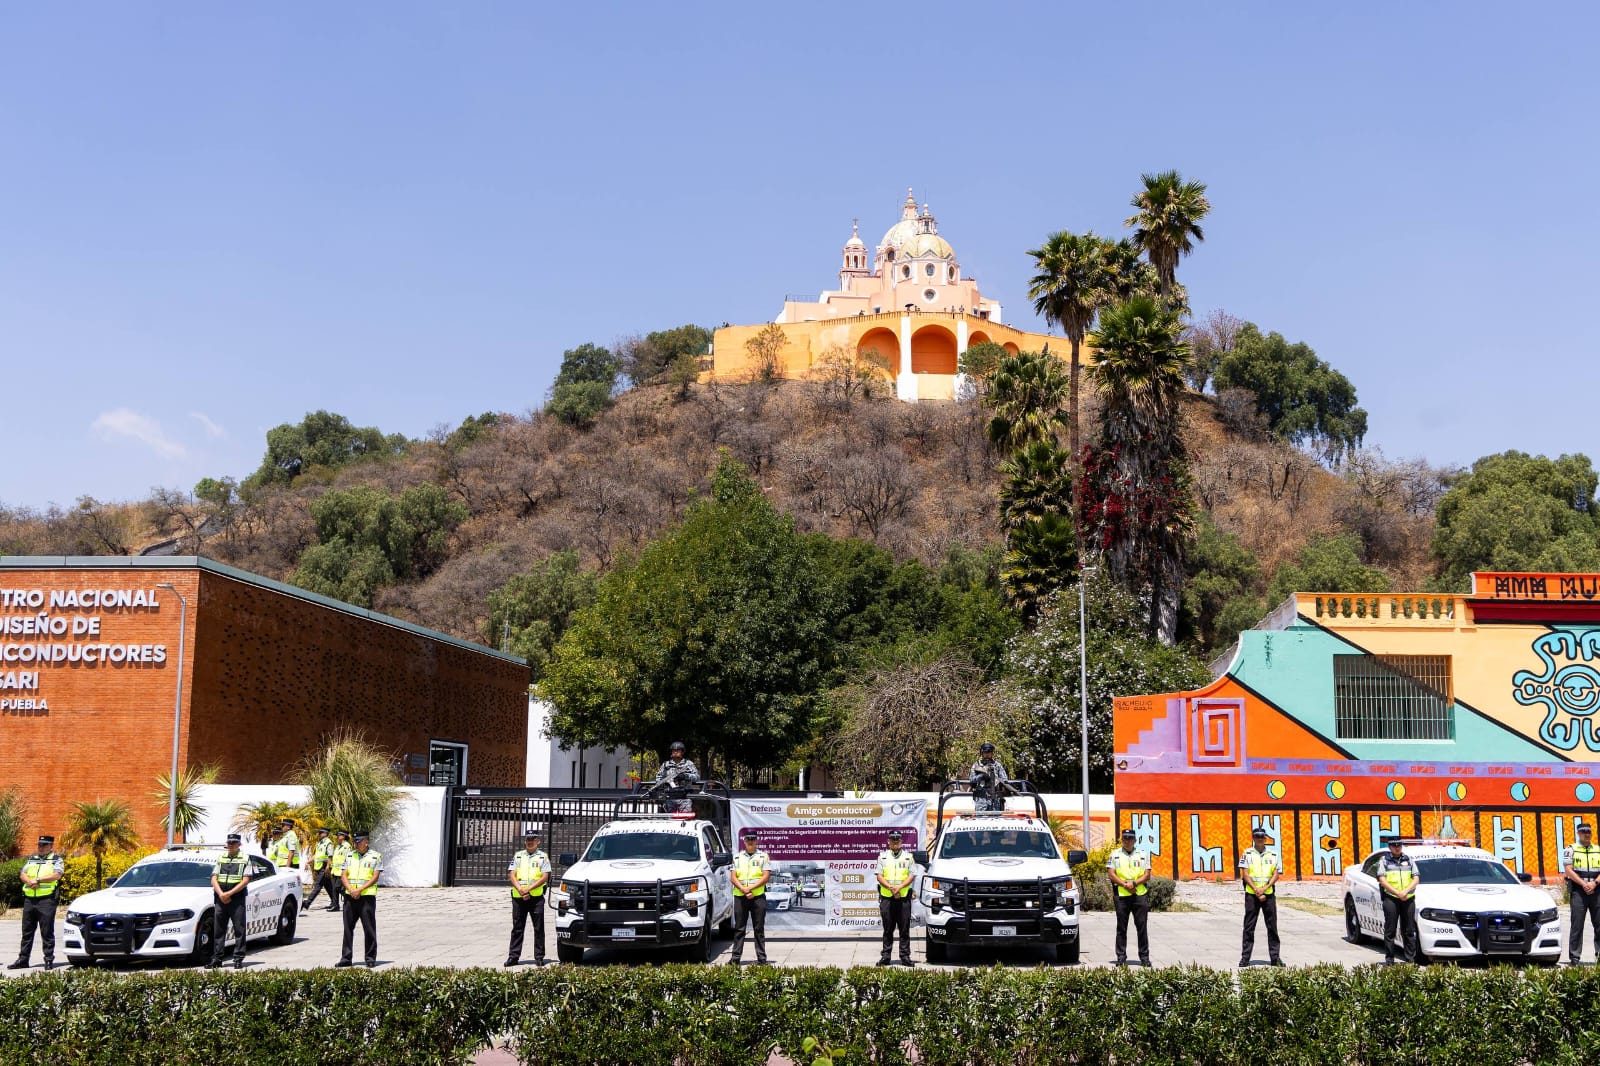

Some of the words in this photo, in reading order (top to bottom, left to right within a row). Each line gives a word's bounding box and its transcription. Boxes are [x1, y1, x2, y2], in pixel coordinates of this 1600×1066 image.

[0, 589, 44, 607] TRO
[50, 589, 160, 607] NACIONAL
[0, 611, 67, 635] ISEÑO
[73, 617, 100, 634] DE
[2, 699, 48, 710] PUEBLA
[794, 807, 823, 816] Amigo
[825, 806, 873, 815] Conductor
[798, 818, 808, 826] La
[810, 818, 839, 826] Guardia
[829, 861, 868, 871] Repórtalo
[583, 888, 671, 896] HEVROLET
[841, 918, 875, 926] denuncia
[160, 927, 181, 935] 31993
[679, 929, 700, 938] 27137
